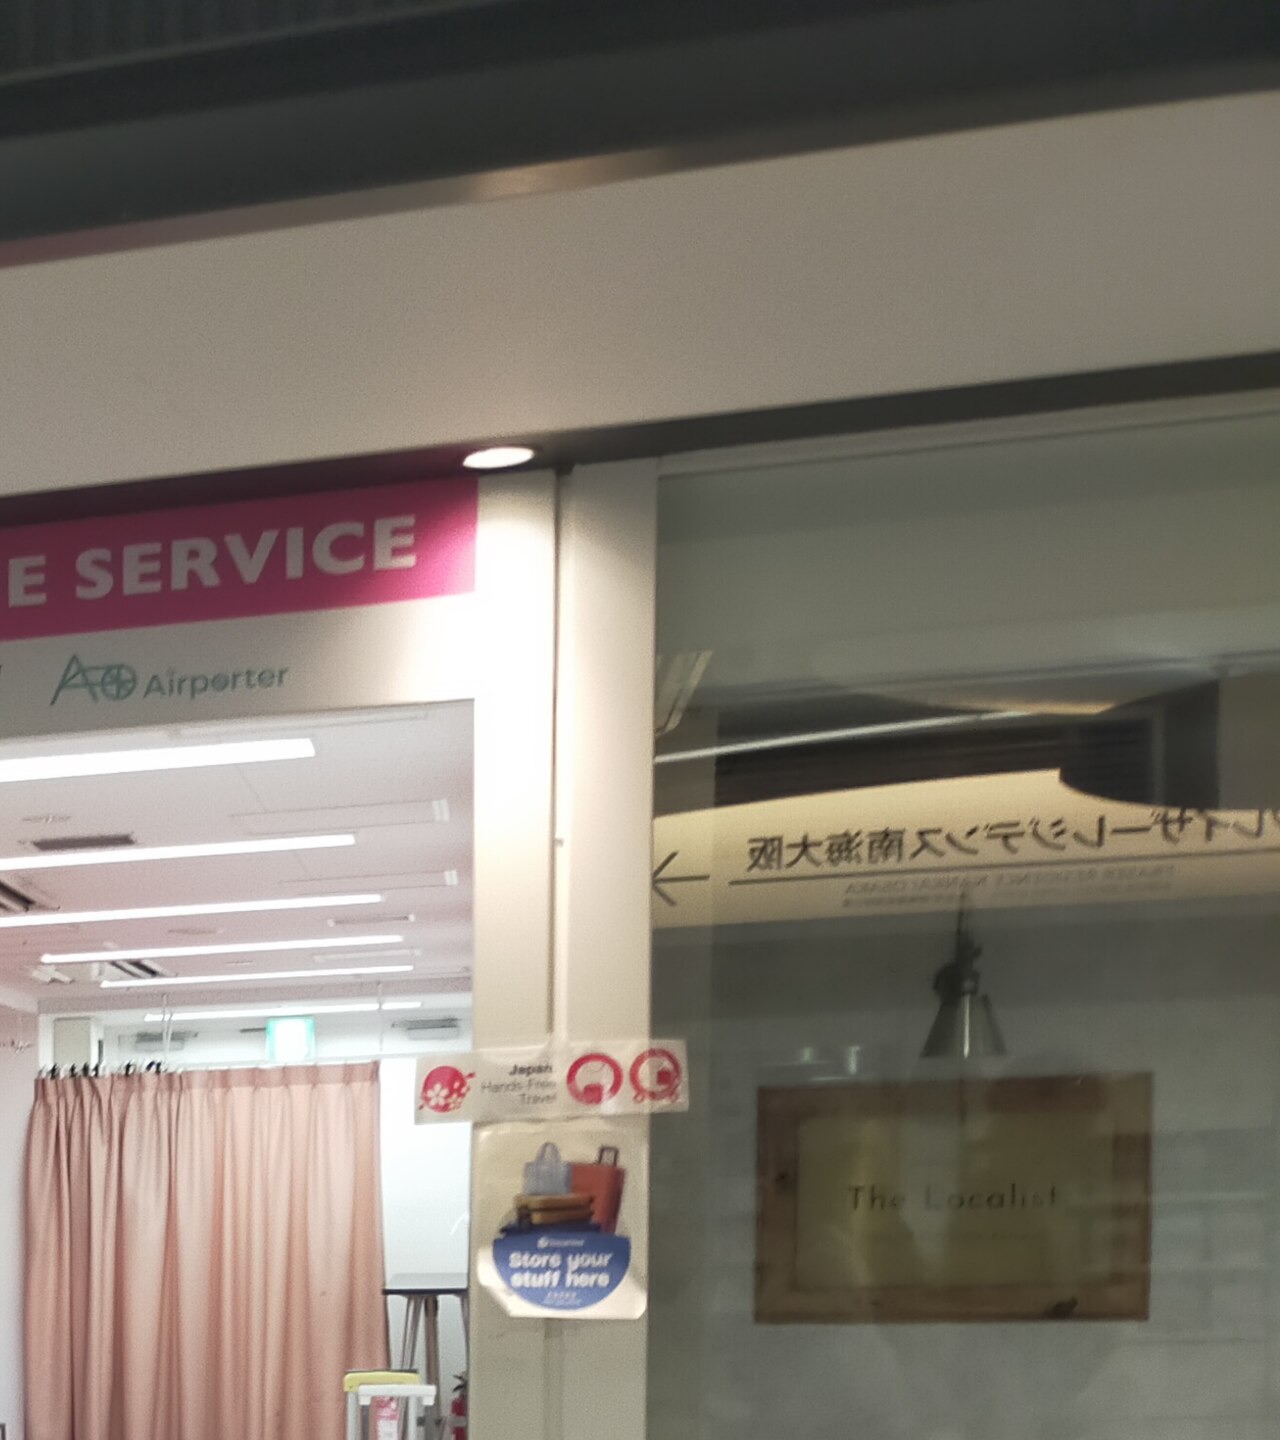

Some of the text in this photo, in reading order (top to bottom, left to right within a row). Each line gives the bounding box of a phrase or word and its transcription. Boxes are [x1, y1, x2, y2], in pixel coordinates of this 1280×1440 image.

[73, 514, 418, 601] SERVICE
[143, 666, 291, 699] Airporter
[509, 1251, 613, 1270] Store your
[510, 1270, 610, 1288] stuff here
